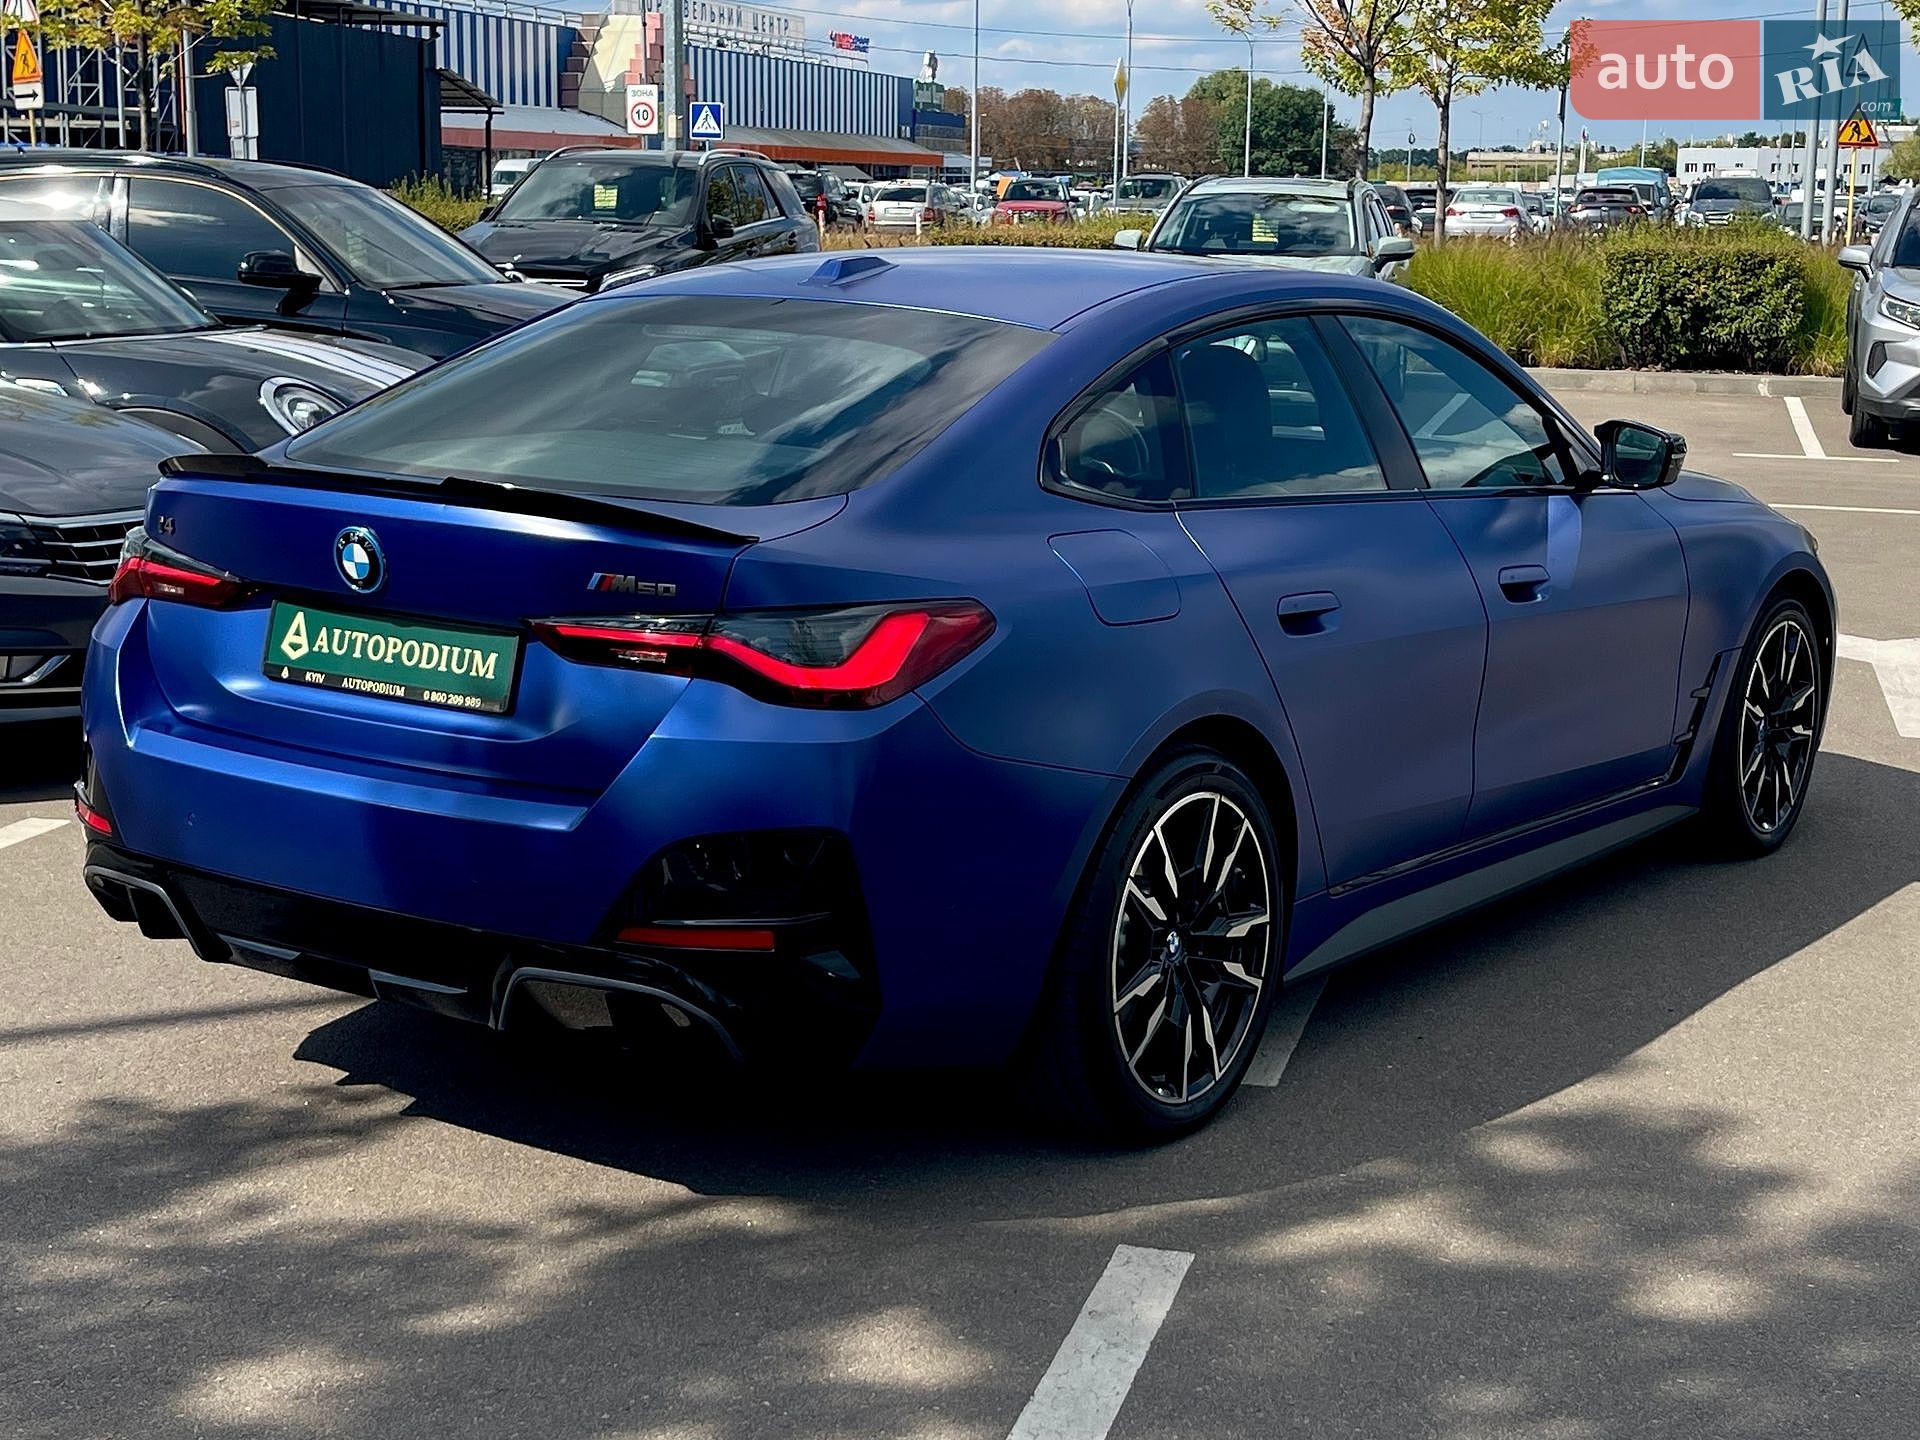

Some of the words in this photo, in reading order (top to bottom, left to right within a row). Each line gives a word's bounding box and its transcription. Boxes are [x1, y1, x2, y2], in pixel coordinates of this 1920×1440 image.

[752, 12, 790, 36] ЦЕНТР
[630, 89, 654, 98] ЗОНА
[635, 109, 649, 121] 10
[313, 626, 499, 679] AUTOPODIUM
[305, 671, 326, 684] KYIV
[342, 677, 406, 697] AUTOPODIUM
